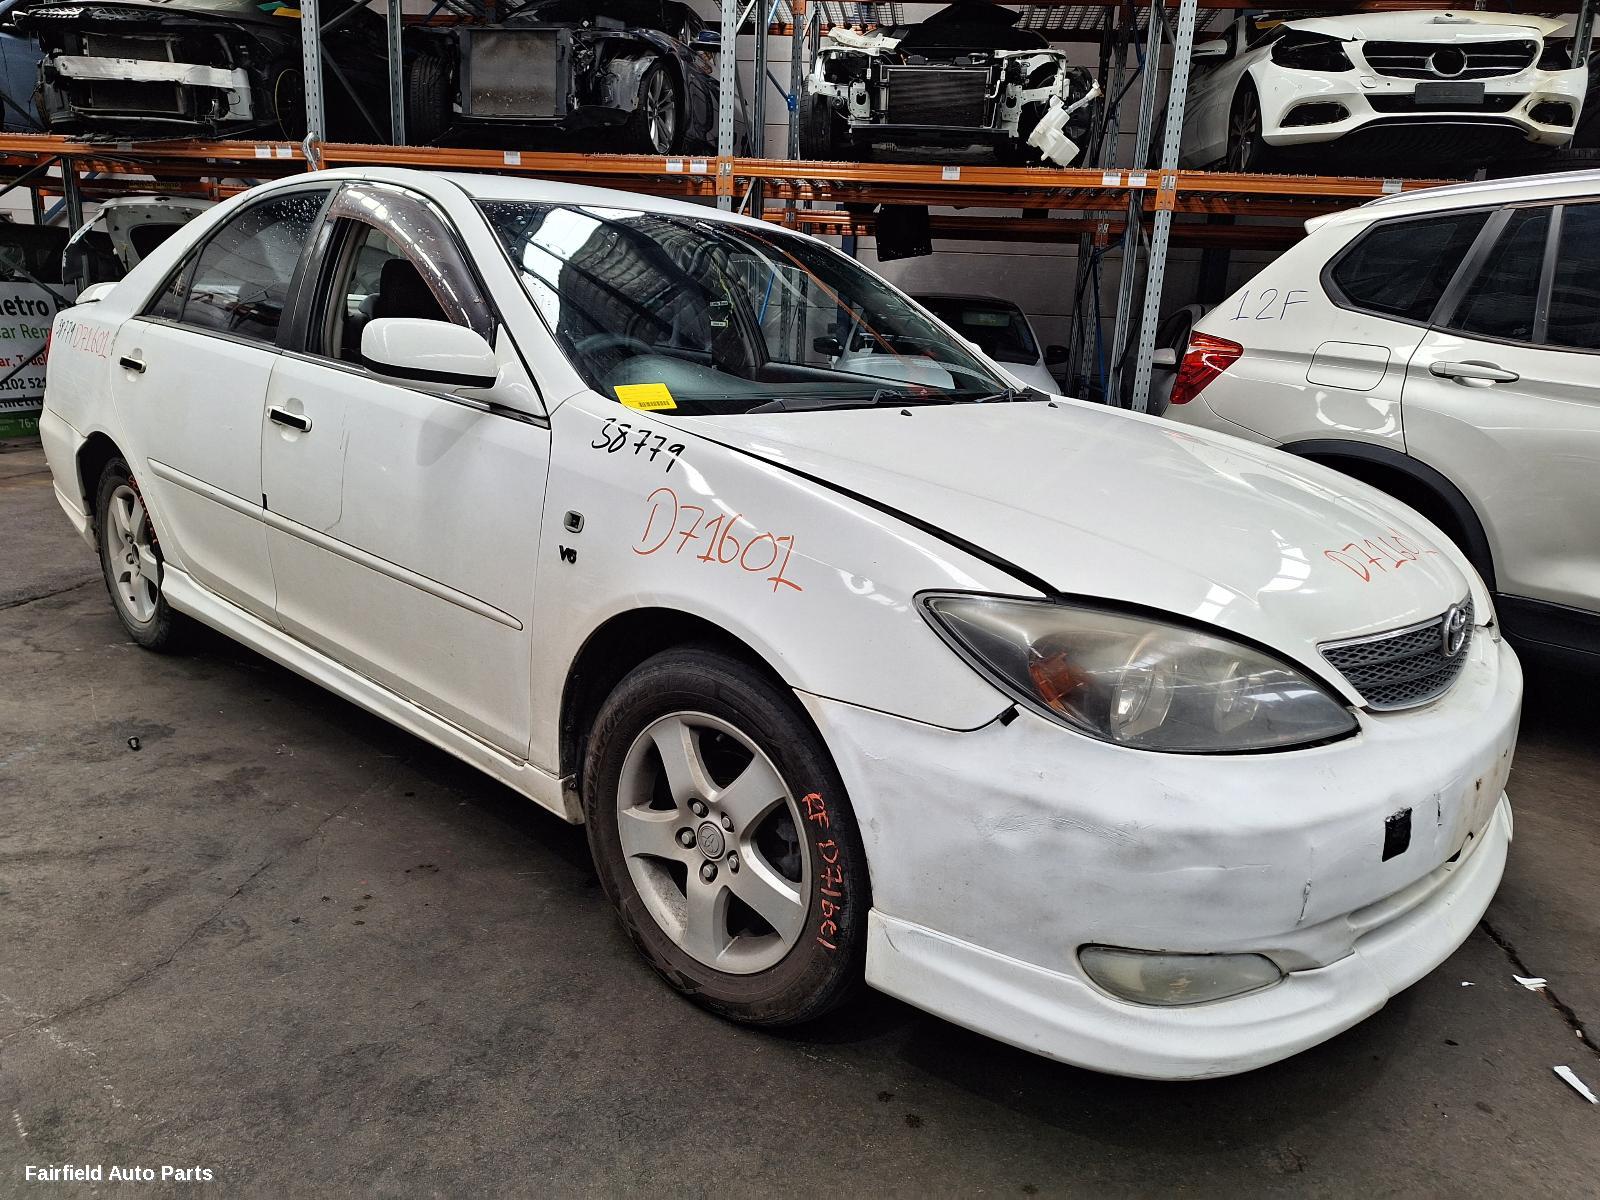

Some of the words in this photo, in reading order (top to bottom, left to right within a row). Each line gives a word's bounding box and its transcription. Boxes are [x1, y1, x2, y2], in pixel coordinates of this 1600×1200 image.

[0, 295, 50, 316] etro
[1230, 288, 1309, 321] 12F
[632, 488, 803, 593] D71601
